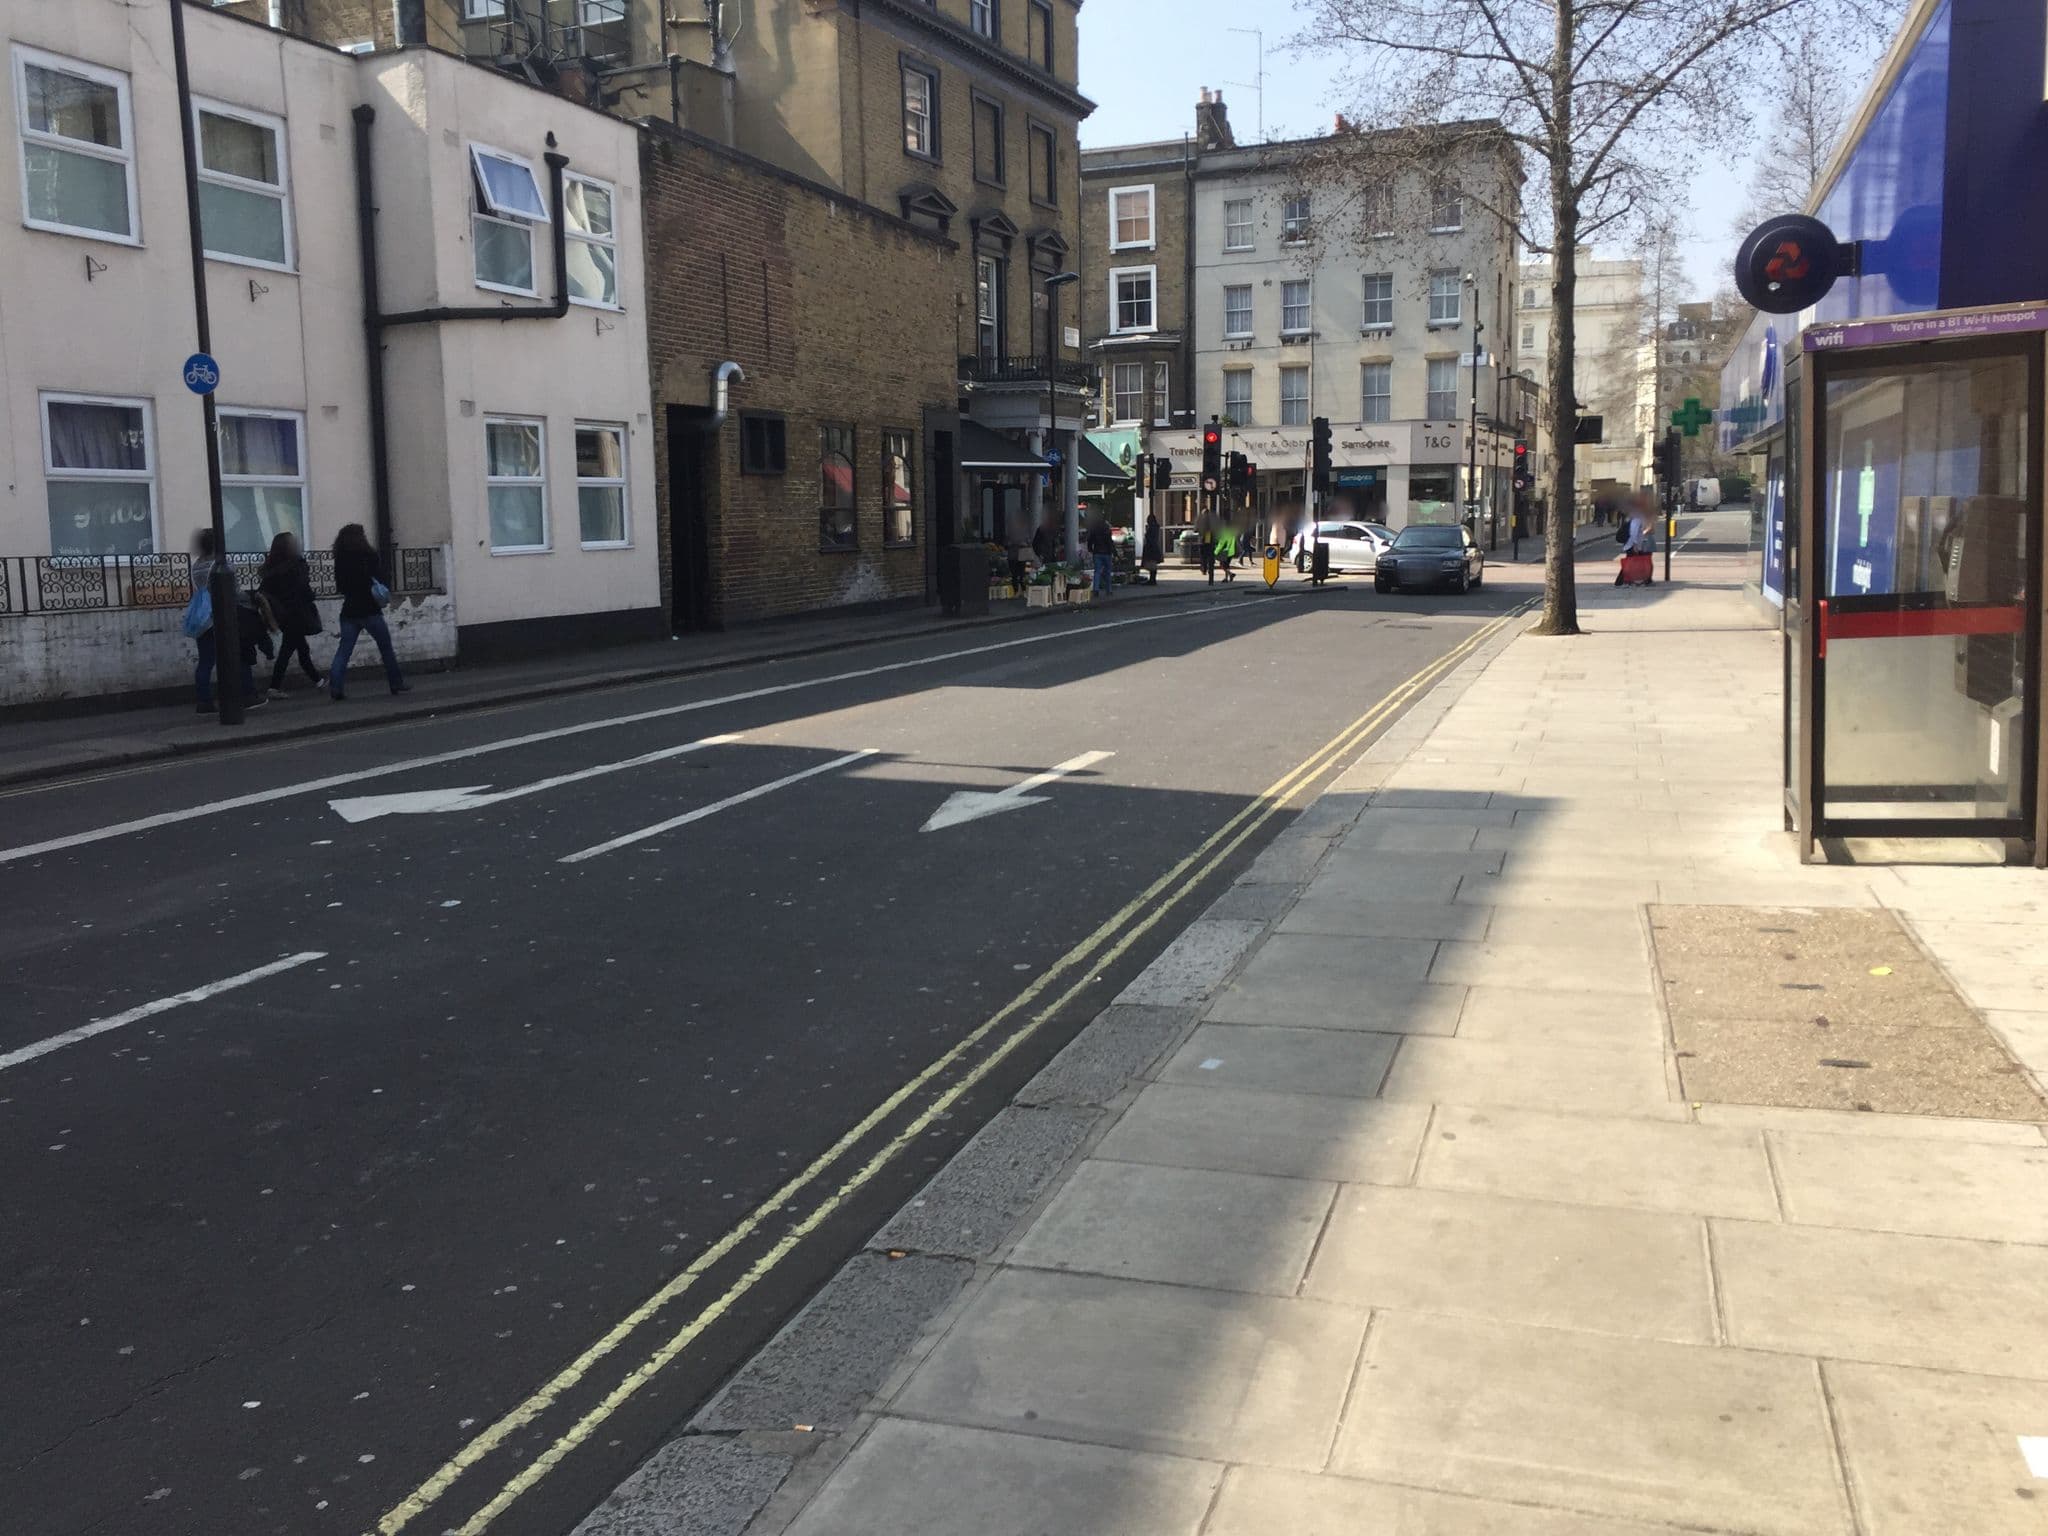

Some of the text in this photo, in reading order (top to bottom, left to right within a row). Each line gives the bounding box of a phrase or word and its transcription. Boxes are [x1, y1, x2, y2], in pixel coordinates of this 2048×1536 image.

[1926, 319, 1937, 328] in
[1948, 316, 1961, 326] BT
[1992, 311, 2037, 324] hotspot
[1281, 440, 1306, 448] Gibb
[1341, 440, 1391, 449] Samsonite
[1424, 436, 1451, 448] T&G
[1169, 447, 1203, 457] Travelp
